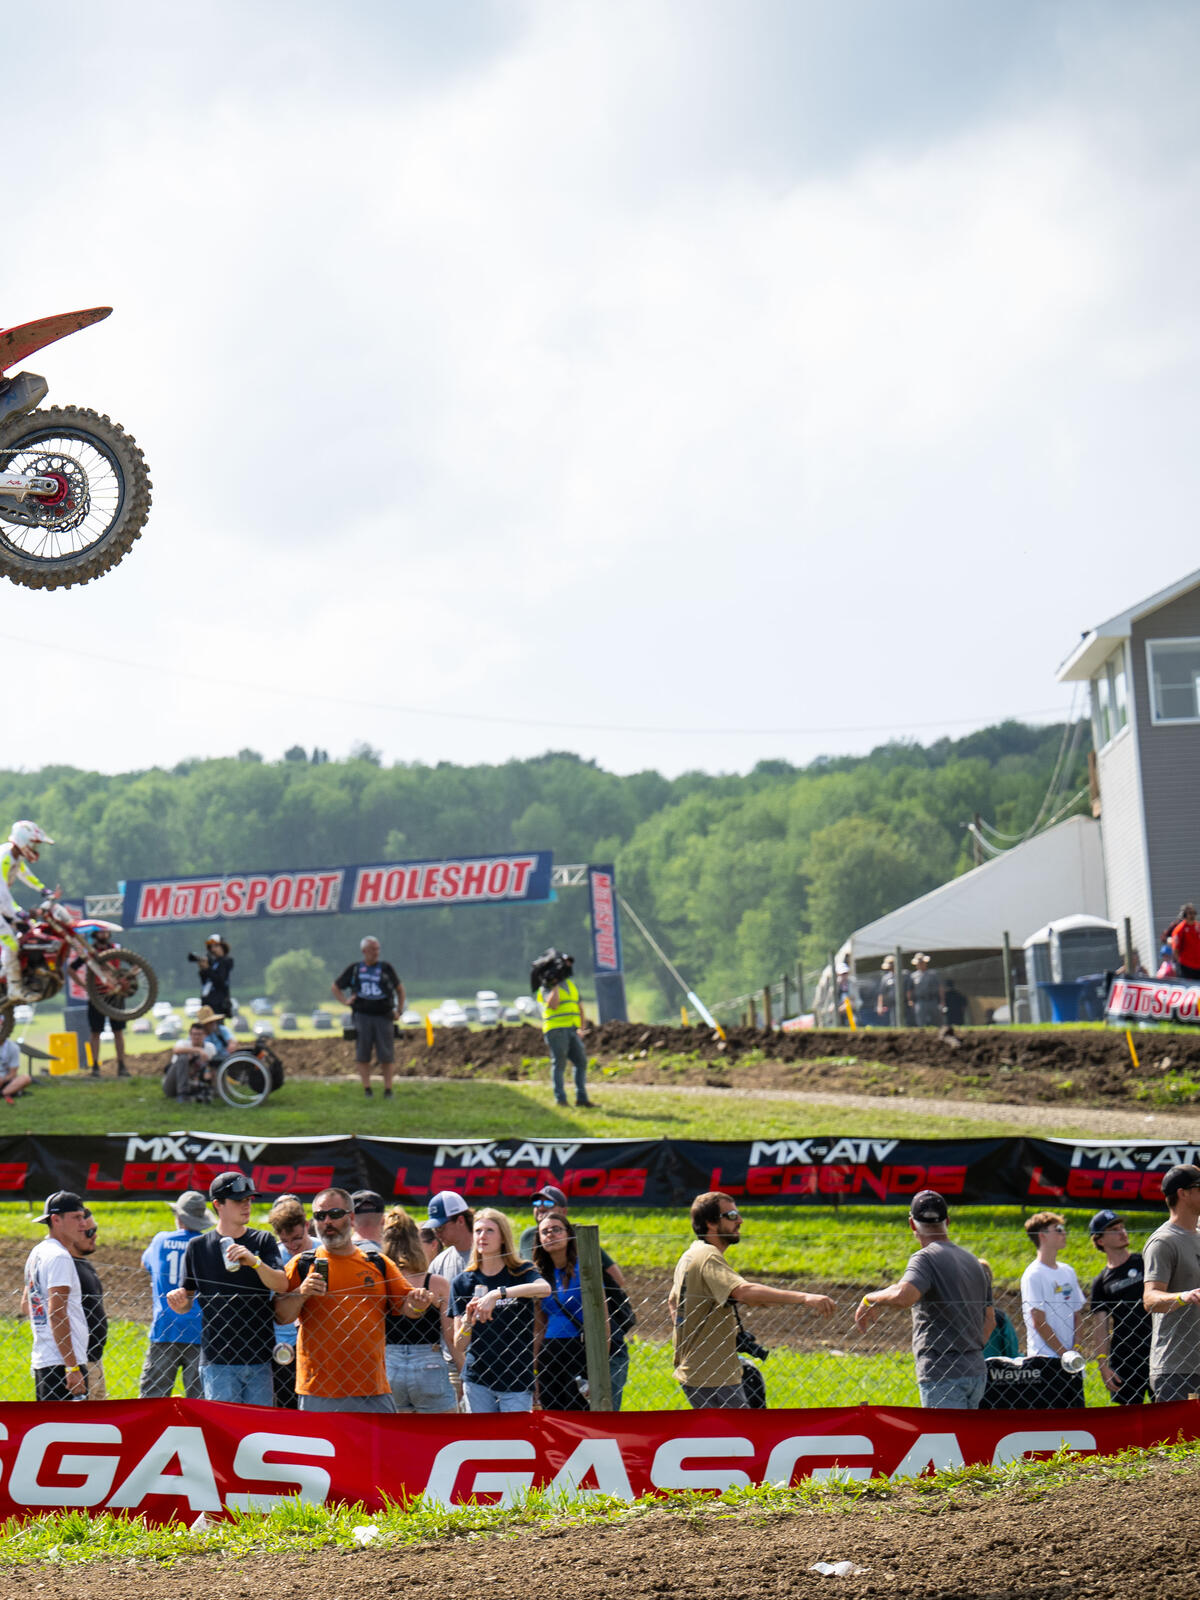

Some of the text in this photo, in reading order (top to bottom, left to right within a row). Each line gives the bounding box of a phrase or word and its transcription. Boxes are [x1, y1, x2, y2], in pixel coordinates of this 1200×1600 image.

[141, 860, 533, 919] MOTOSPORT HOLESHOT
[1108, 984, 1200, 1017] MOTOSPO
[709, 1165, 968, 1200] LEGENDS
[990, 1368, 1040, 1381] Wayne
